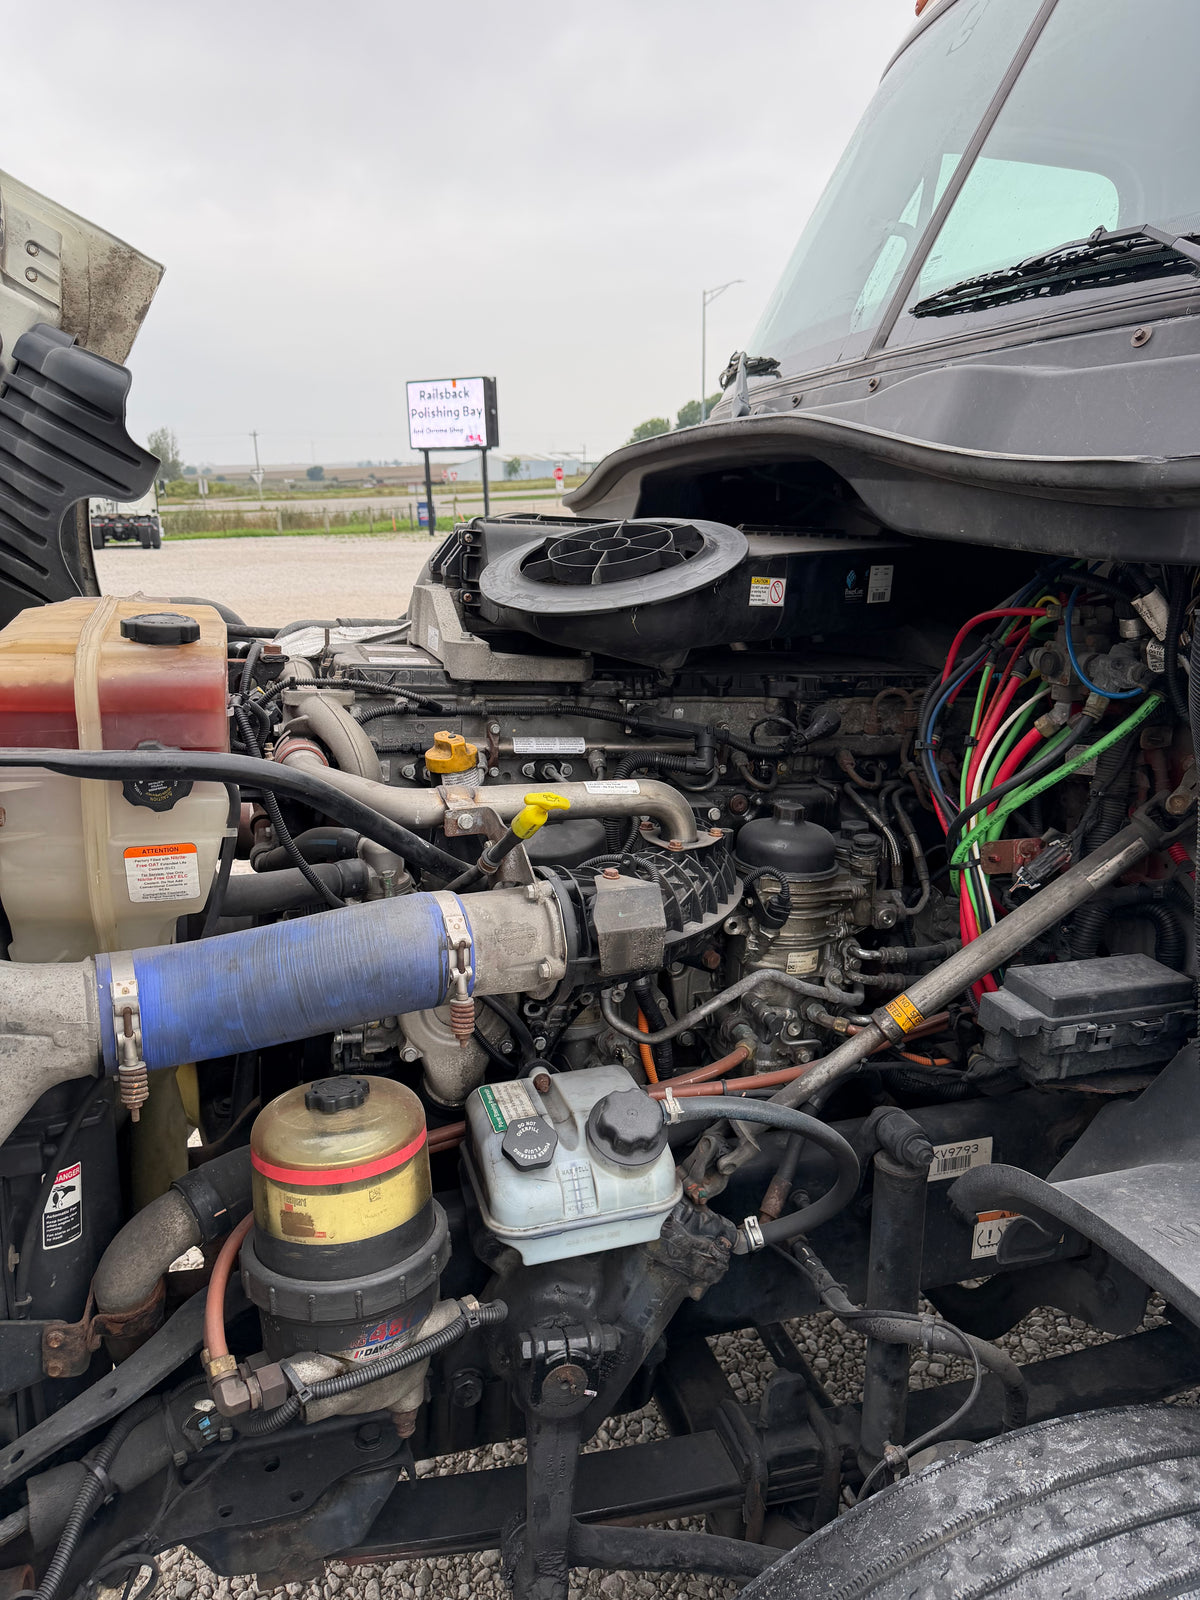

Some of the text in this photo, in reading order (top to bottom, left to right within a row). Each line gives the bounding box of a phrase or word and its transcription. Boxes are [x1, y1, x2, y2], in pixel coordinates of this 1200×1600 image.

[419, 386, 470, 400] Railsback
[411, 405, 483, 420] Polishing Bay
[142, 846, 179, 854] ATTENTION
[886, 1003, 903, 1018] STEP
[516, 1126, 539, 1137] OVERFILL
[512, 1142, 551, 1160] POWER STEERING
[524, 1146, 542, 1154] FLUID
